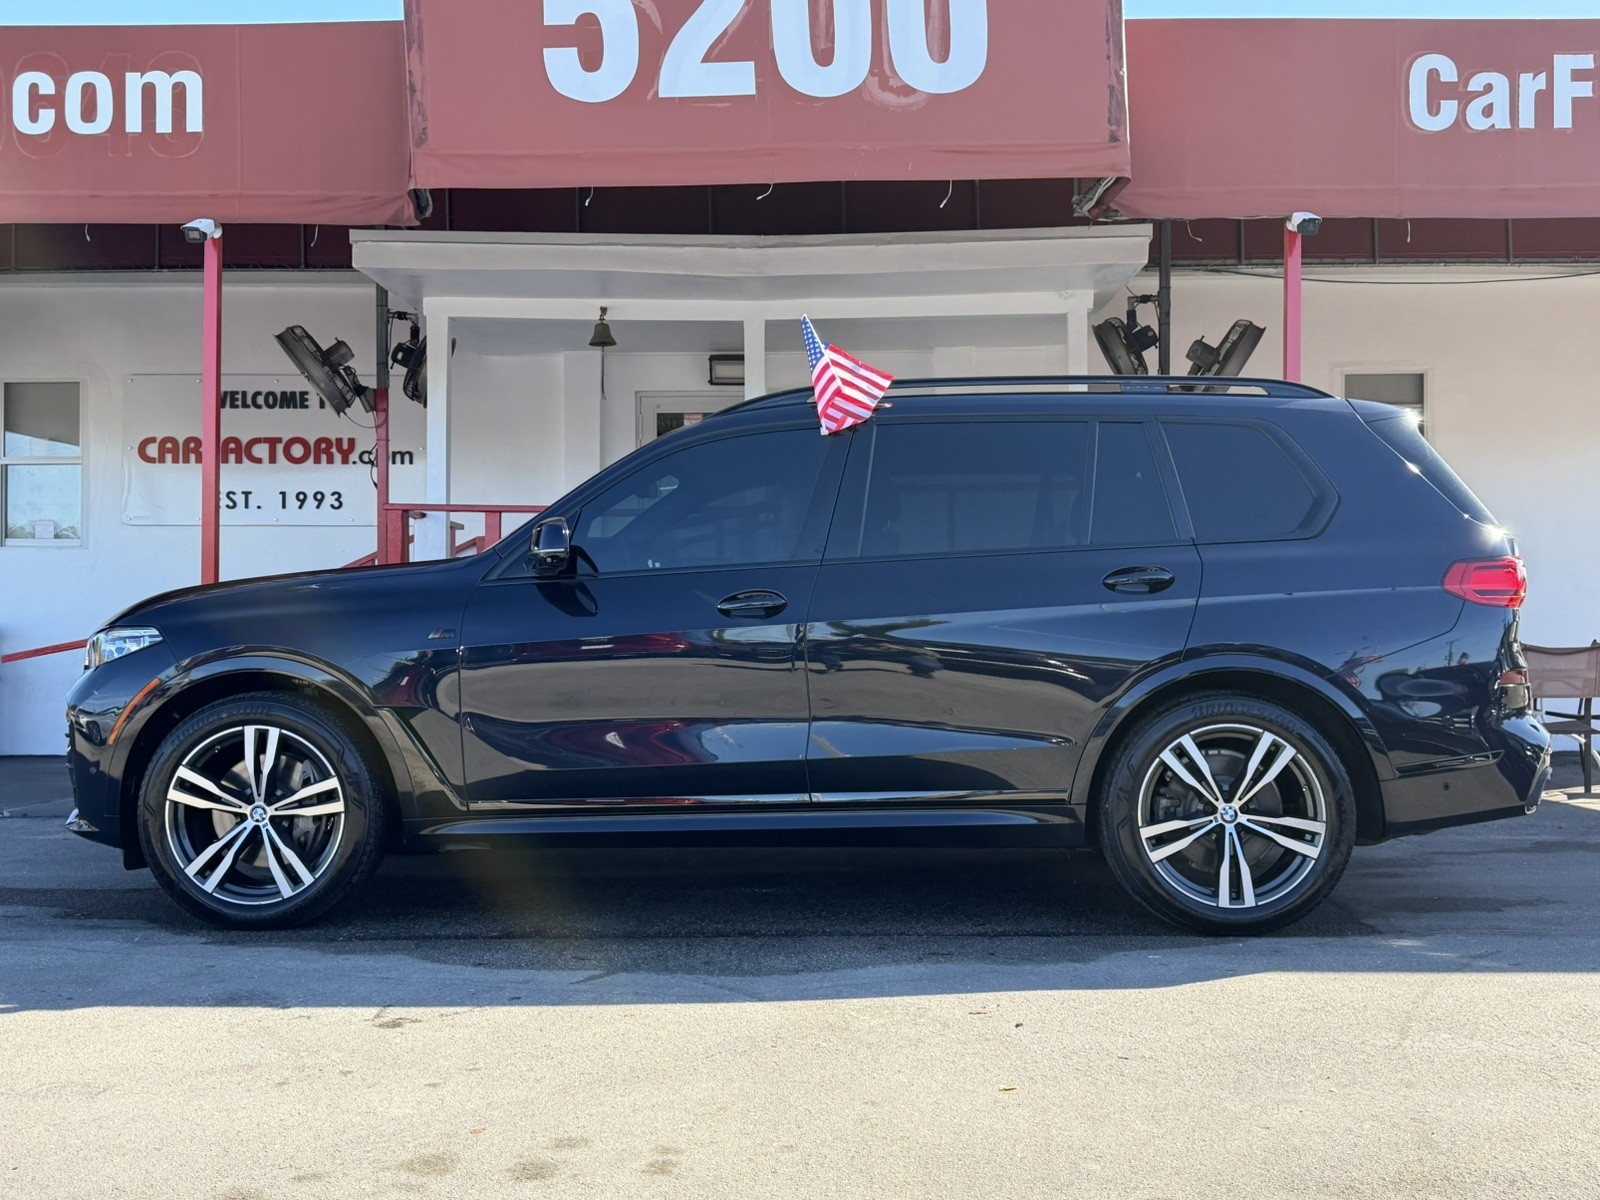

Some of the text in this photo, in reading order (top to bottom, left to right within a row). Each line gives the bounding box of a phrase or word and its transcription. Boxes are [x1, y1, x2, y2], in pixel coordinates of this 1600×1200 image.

[543, 0, 988, 103] 5200
[12, 71, 203, 135] com
[1408, 53, 1595, 132] CarF
[137, 436, 414, 465] CARACTORY.cm
[219, 490, 344, 510] ST. 1993
